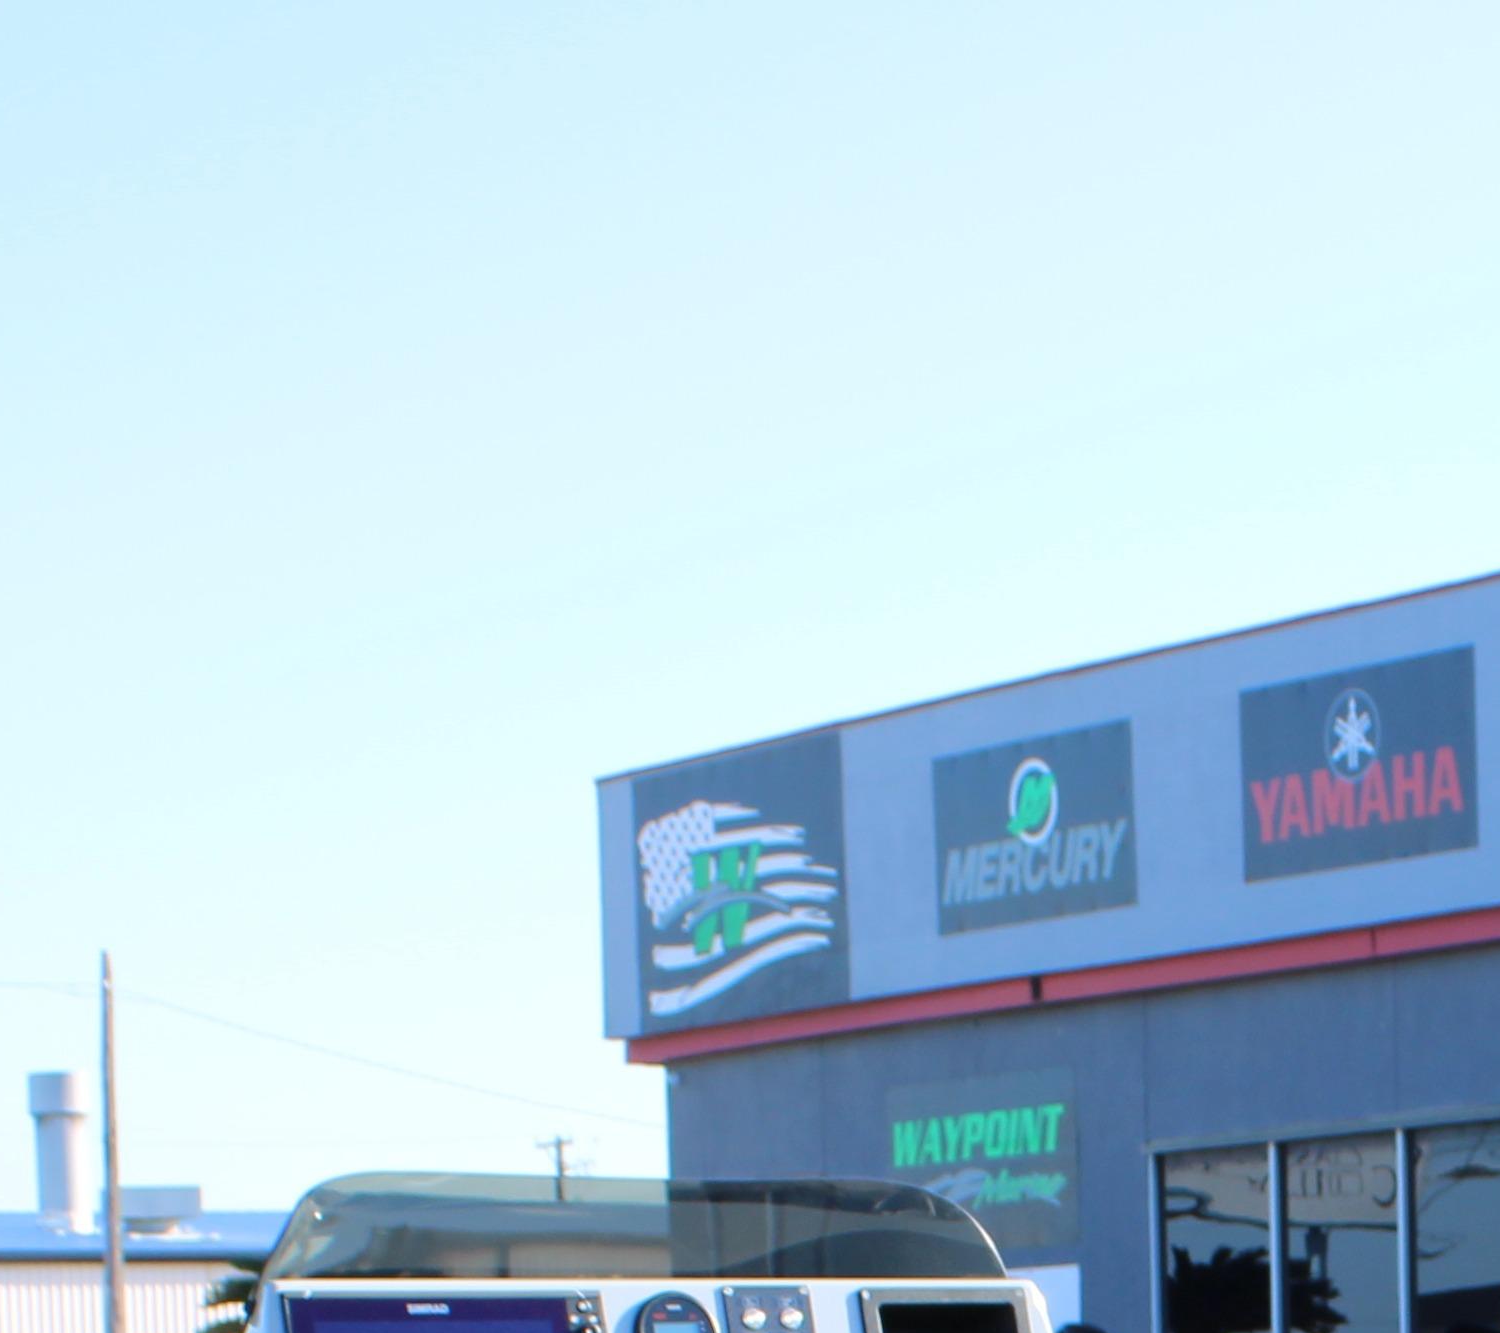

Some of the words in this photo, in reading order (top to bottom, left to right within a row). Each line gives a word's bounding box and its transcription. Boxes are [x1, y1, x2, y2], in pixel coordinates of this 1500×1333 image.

[1250, 746, 1464, 846] YAMAHA
[940, 818, 1128, 906] MERCURY
[892, 1103, 1064, 1168] WAYPOINT
